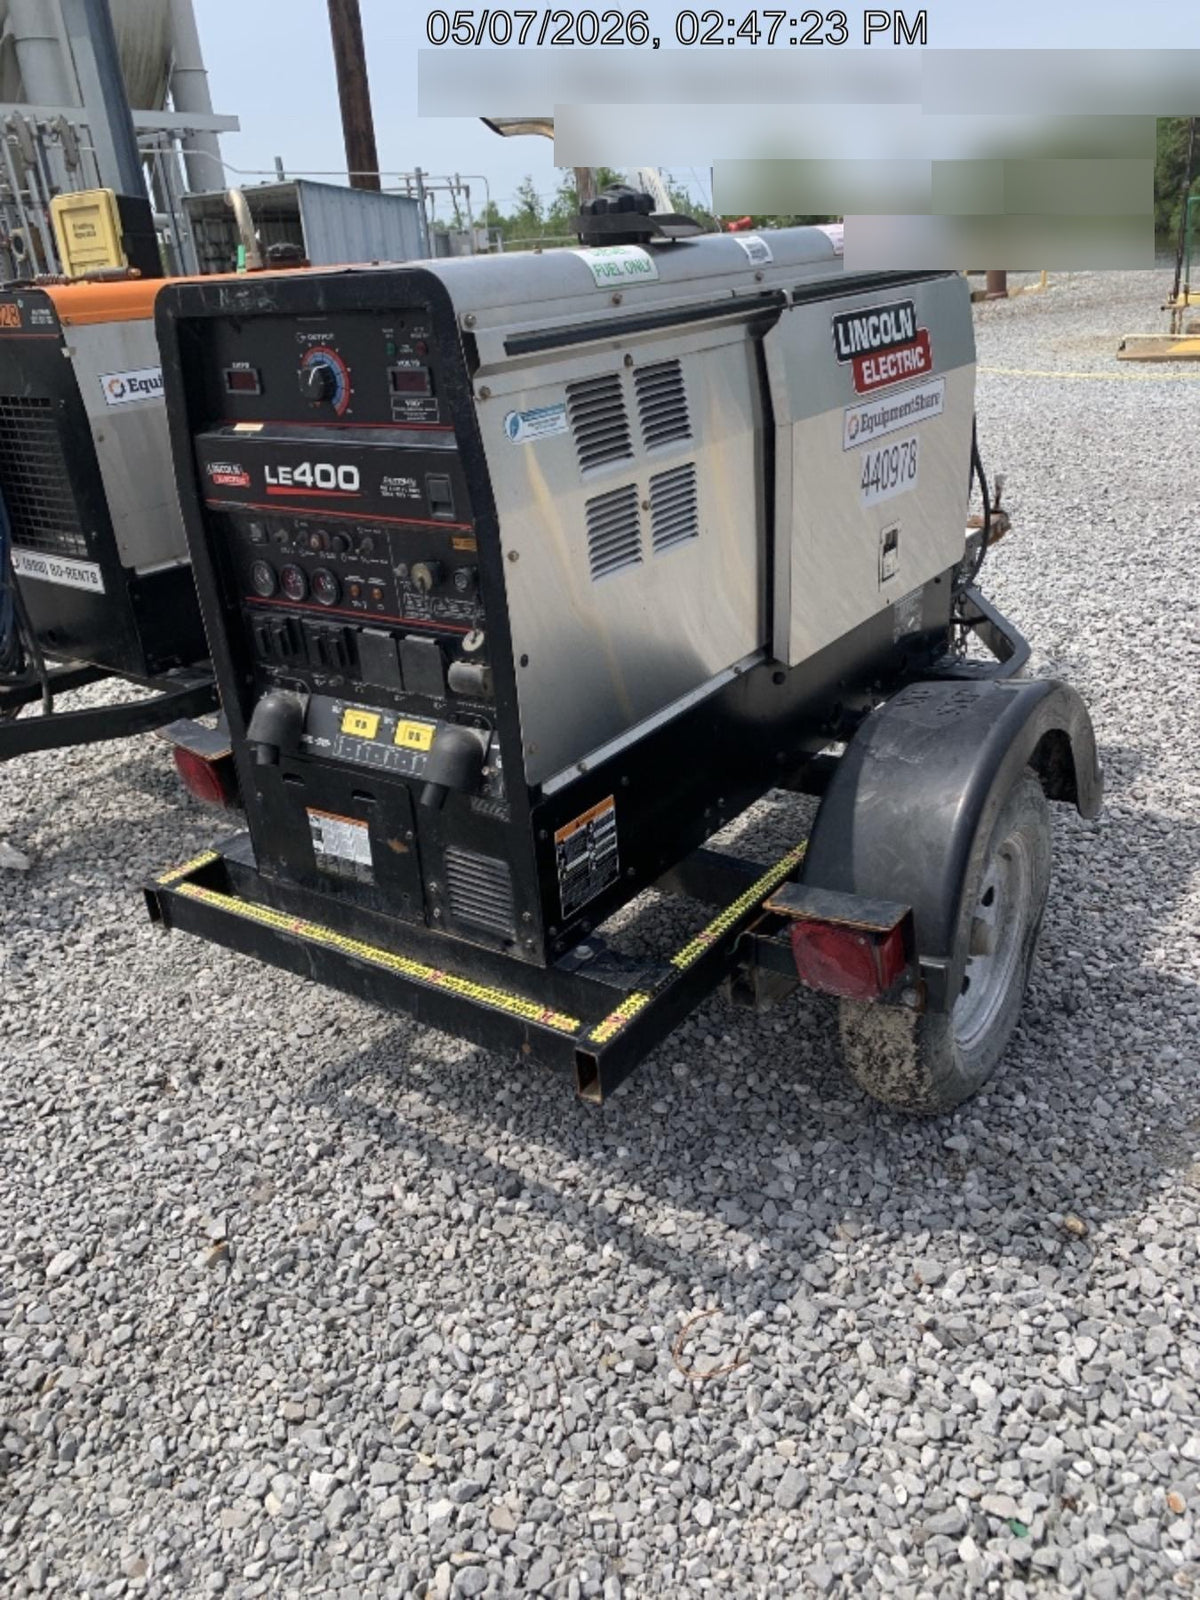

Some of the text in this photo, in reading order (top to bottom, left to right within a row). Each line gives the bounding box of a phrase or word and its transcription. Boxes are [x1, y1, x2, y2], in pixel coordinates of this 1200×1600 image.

[593, 259, 652, 277] FUEL ONLY
[837, 307, 914, 355] LINCOLN
[861, 346, 925, 385] ELECTRIC
[860, 391, 941, 434] EquipmentShare
[264, 461, 360, 491] LE400
[860, 438, 918, 497] 440978
